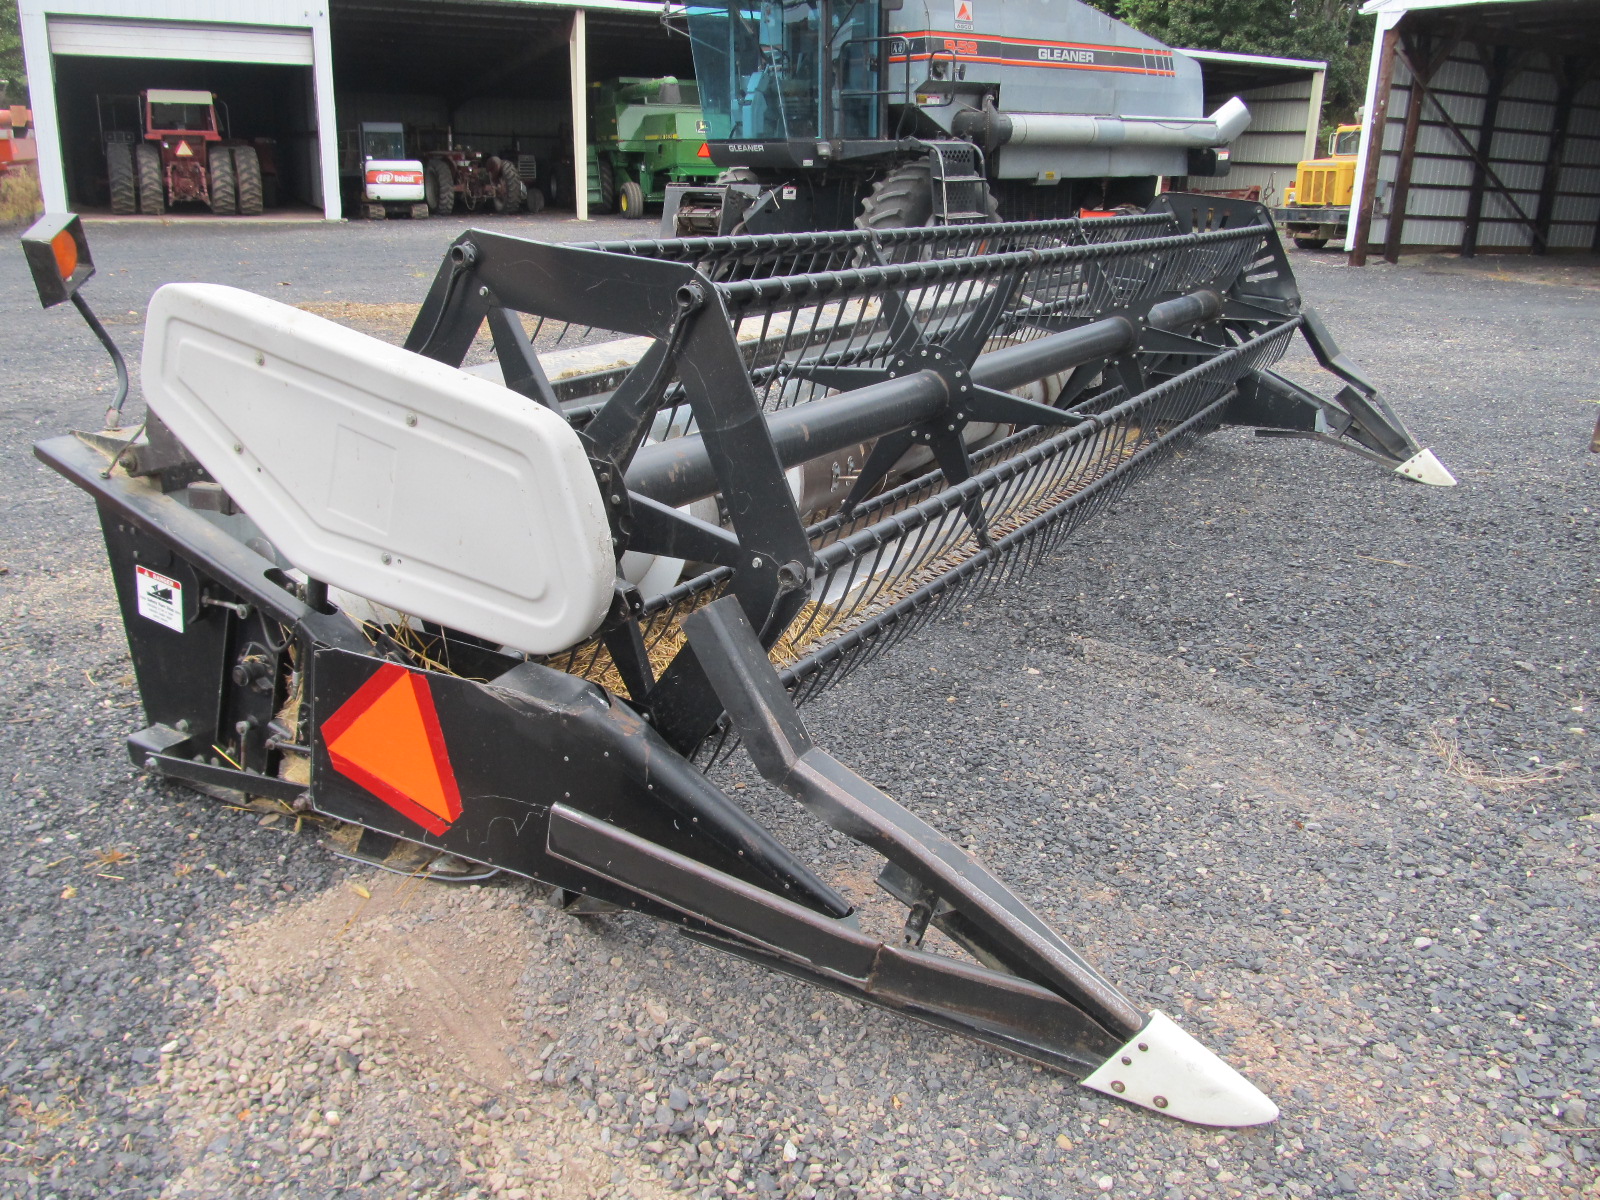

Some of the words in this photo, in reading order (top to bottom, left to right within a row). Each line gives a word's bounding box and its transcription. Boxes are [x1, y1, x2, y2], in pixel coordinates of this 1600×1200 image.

[1038, 48, 1094, 63] GLEANER
[728, 144, 764, 152] GLEANER
[394, 174, 415, 183] Bobcat
[152, 573, 174, 586] DANGER
